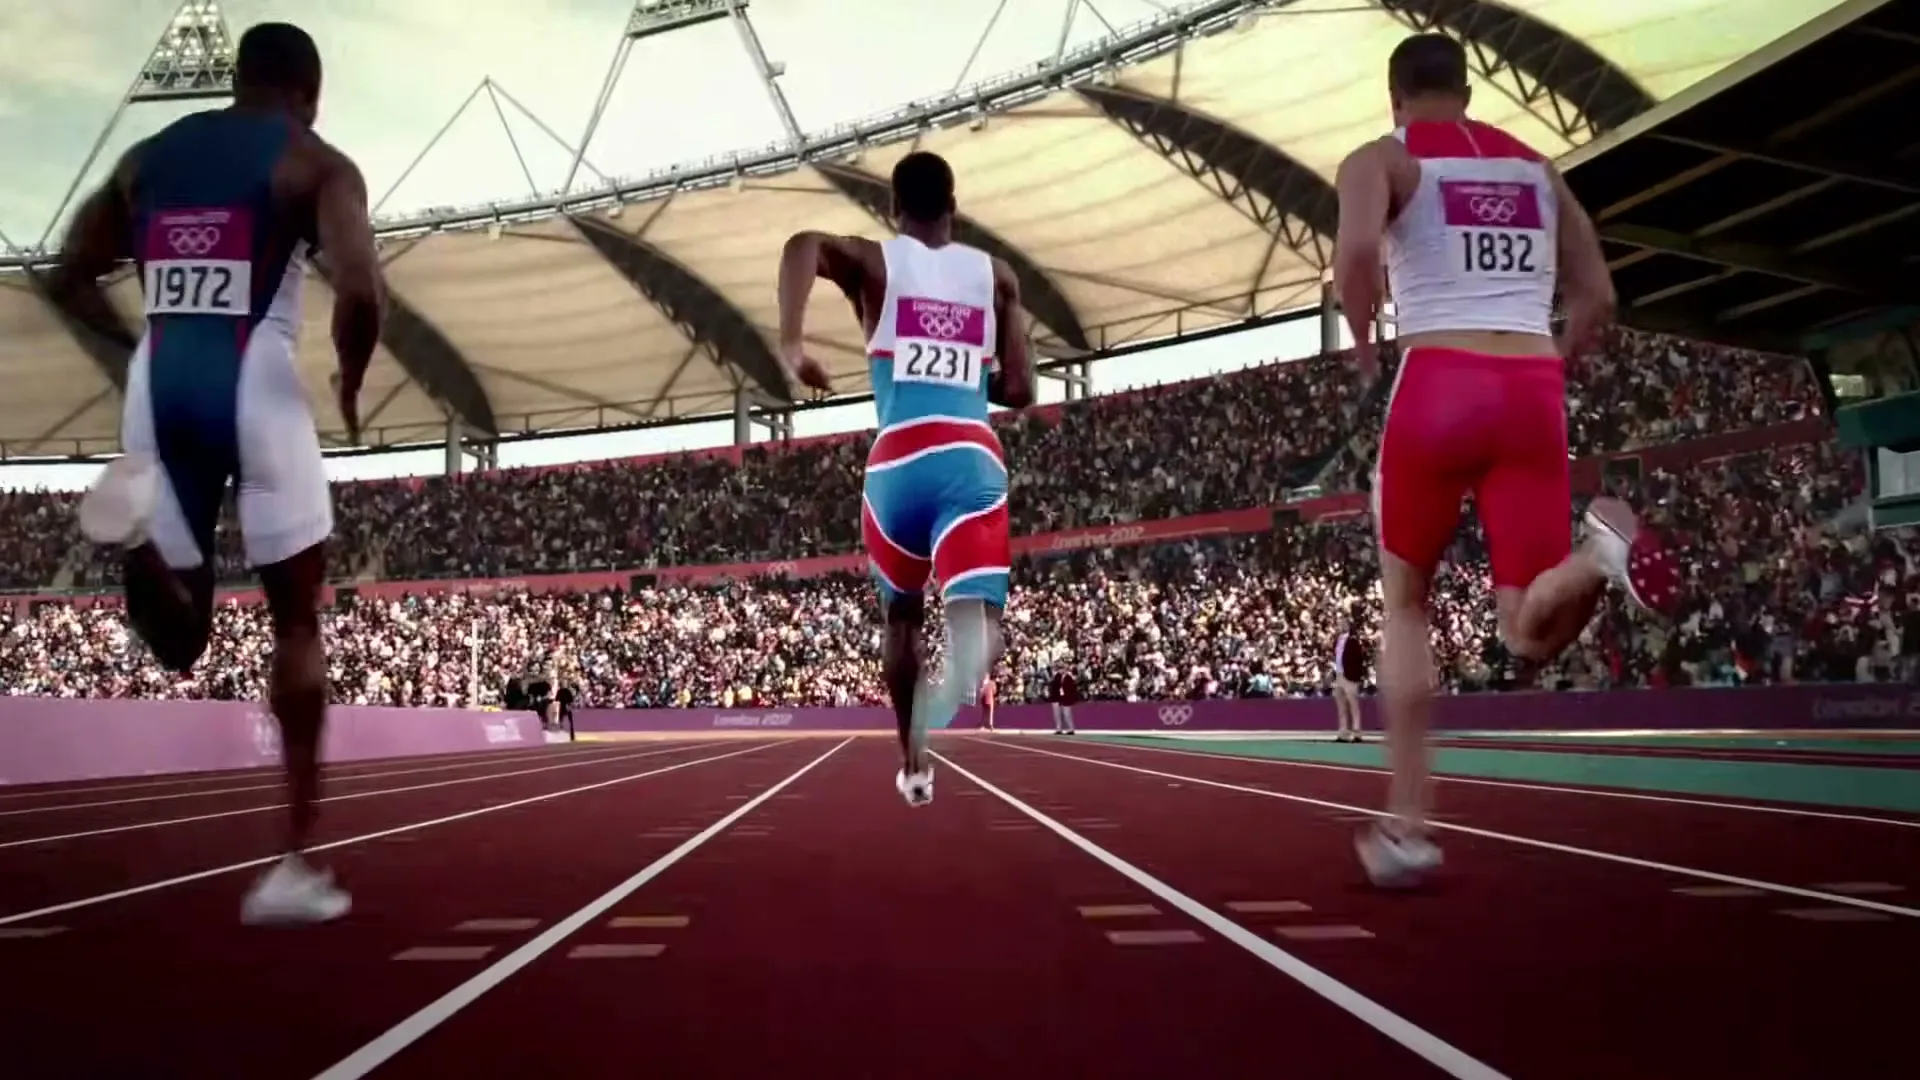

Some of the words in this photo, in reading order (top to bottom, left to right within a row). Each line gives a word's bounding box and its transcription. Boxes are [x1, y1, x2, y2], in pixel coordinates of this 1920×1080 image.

[1462, 231, 1535, 272] 1832
[154, 266, 232, 308] 1972
[906, 342, 970, 382] 2231
[1109, 525, 1145, 542] 2012
